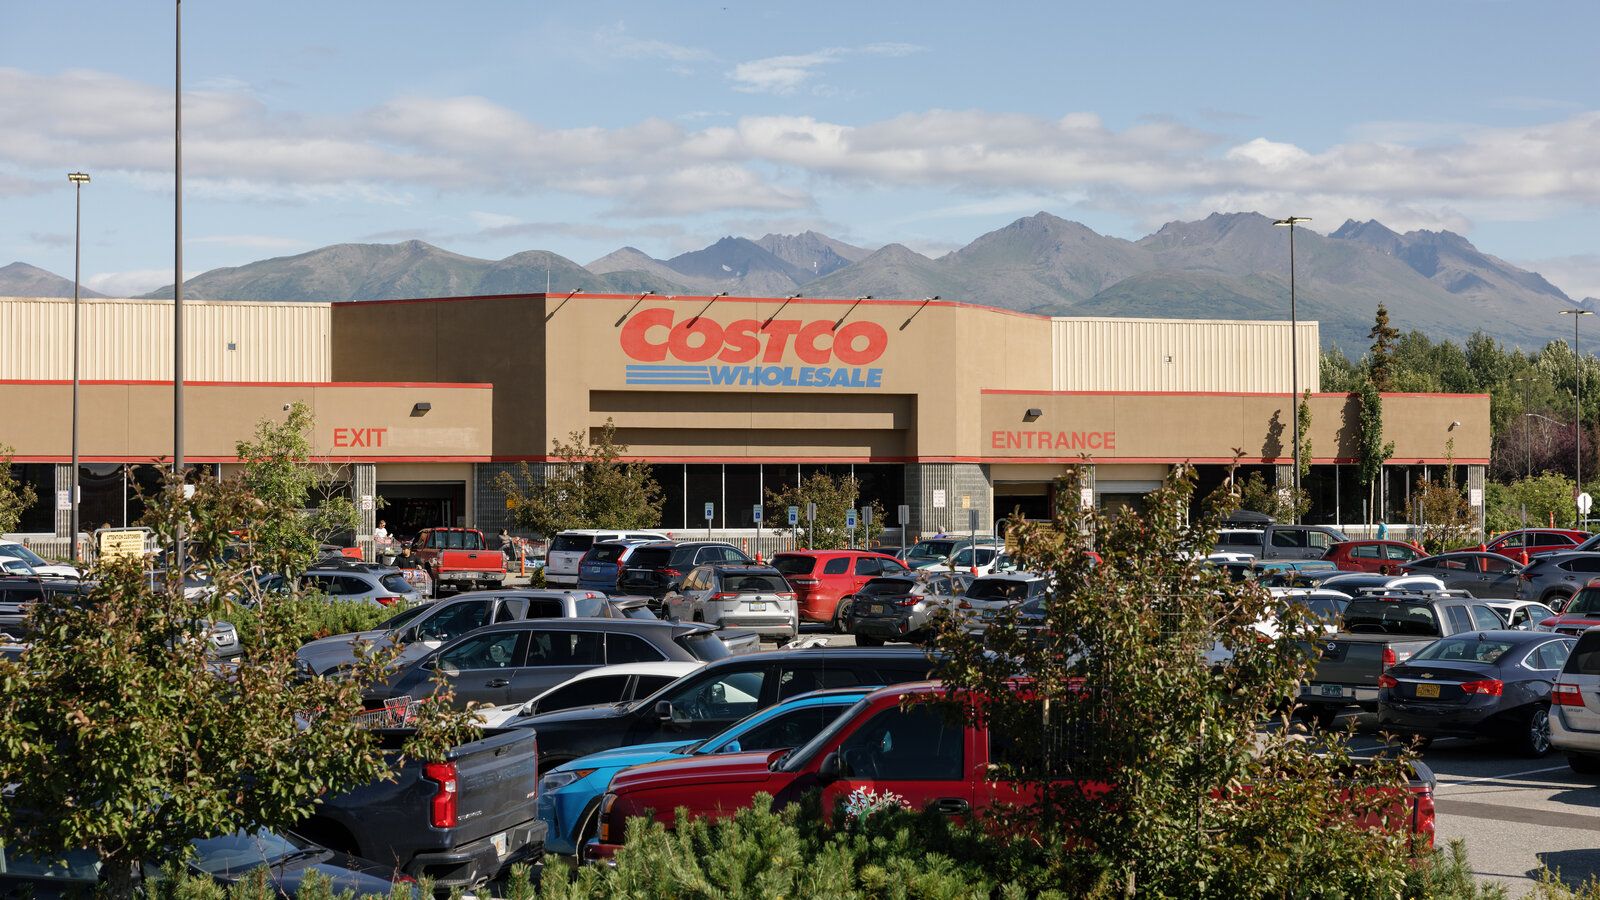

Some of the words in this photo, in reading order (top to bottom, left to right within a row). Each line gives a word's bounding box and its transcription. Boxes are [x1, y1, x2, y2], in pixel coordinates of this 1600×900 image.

[620, 308, 888, 366] COSTCO
[708, 366, 883, 388] WHOLESALE
[333, 428, 388, 448] EXIT
[991, 431, 1116, 450] ENTRANCE
